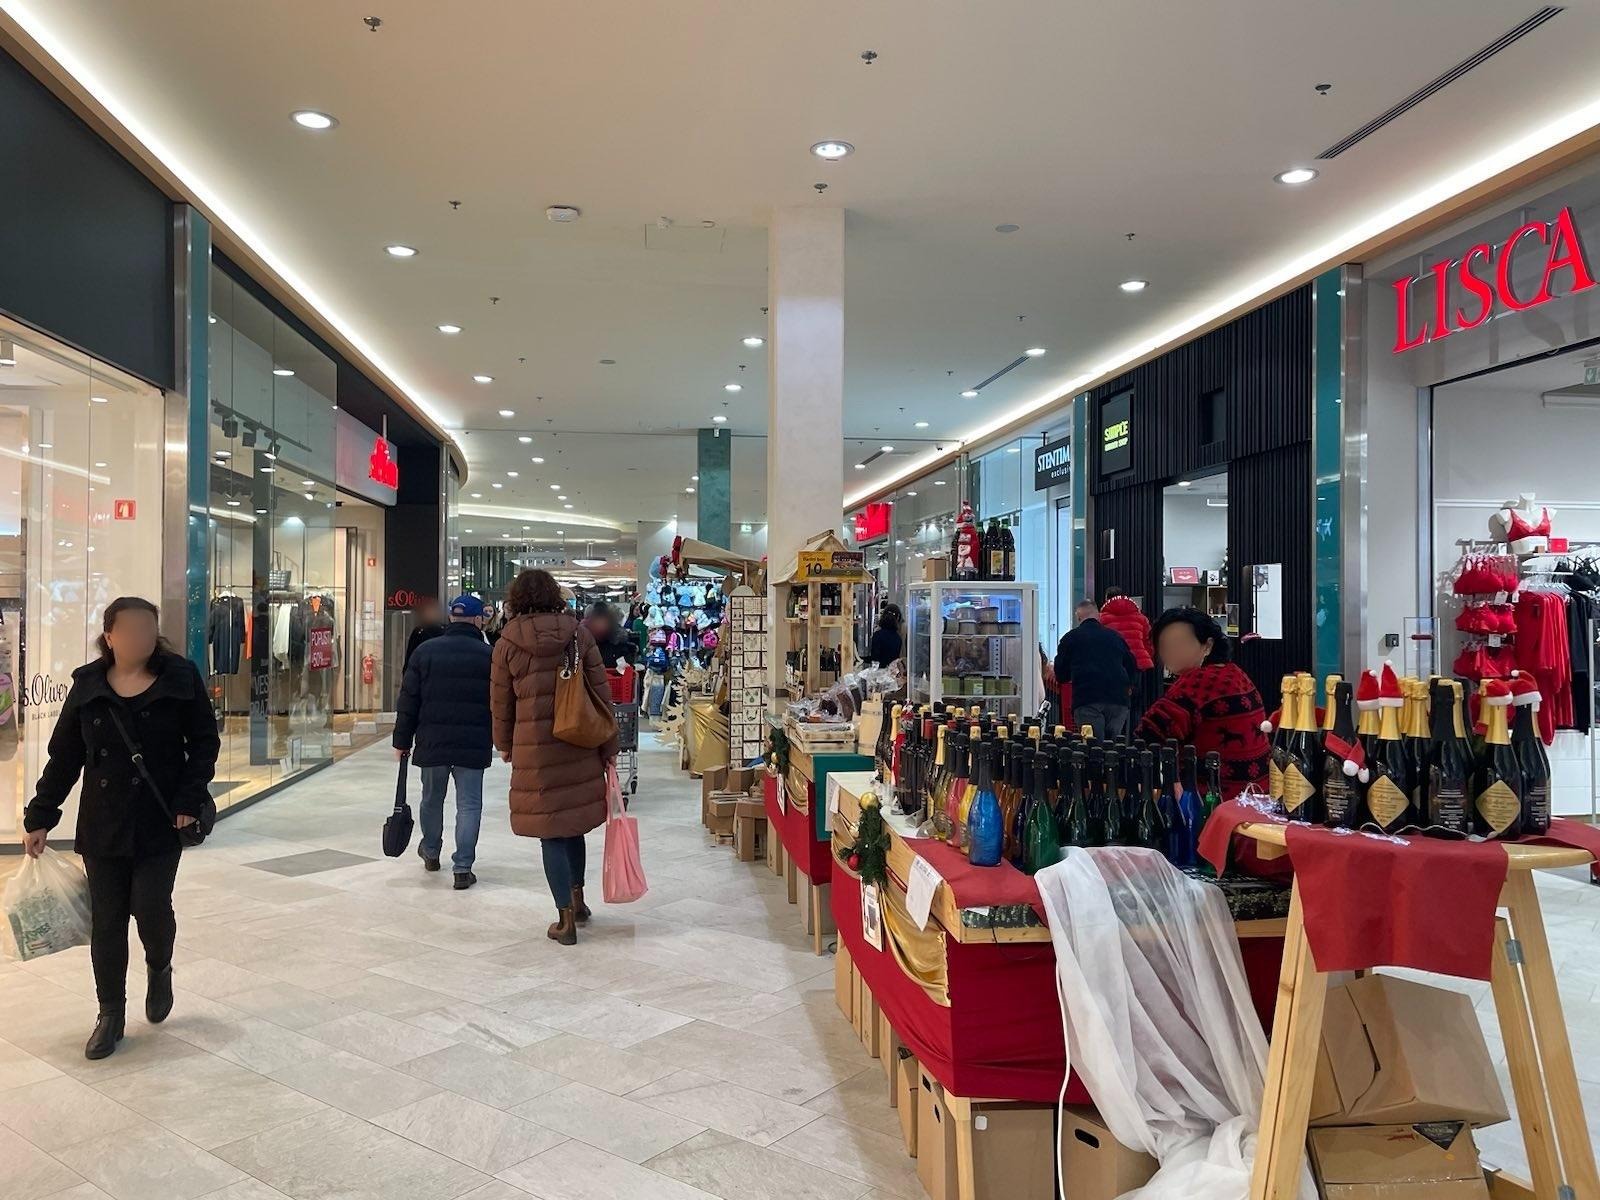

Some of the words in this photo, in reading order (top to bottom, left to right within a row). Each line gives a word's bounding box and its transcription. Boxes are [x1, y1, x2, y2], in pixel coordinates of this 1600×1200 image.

[1392, 207, 1598, 354] LISCA
[1037, 444, 1070, 473] STENTIM
[23, 672, 68, 707] s.Oliver
